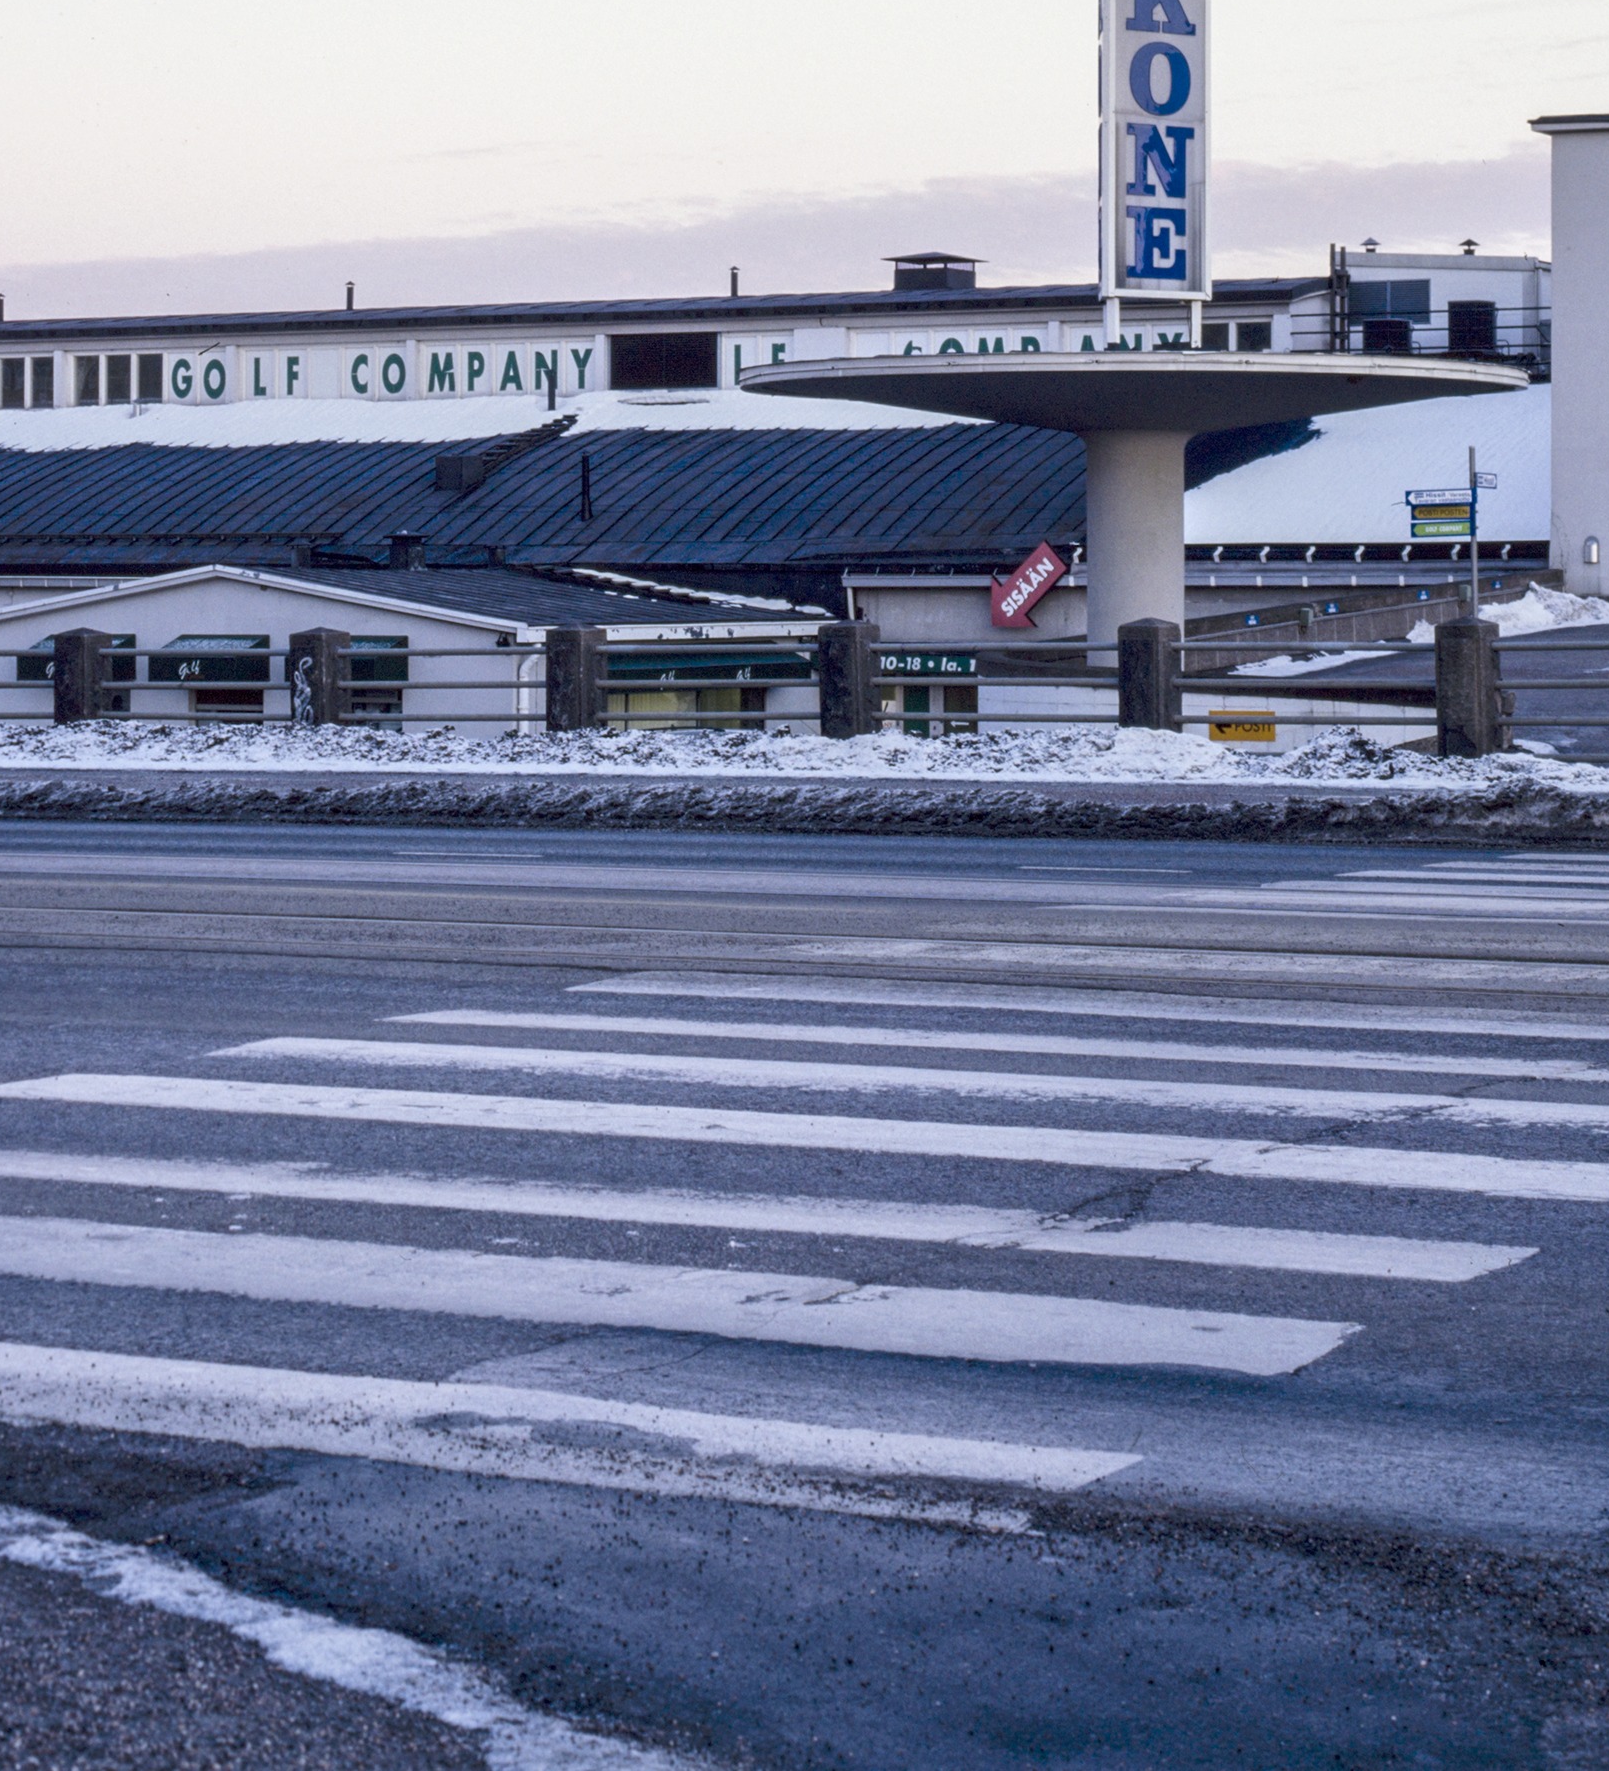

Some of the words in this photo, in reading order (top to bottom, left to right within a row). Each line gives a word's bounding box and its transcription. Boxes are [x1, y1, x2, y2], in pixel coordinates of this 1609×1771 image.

[171, 356, 299, 399] GOLF
[351, 348, 593, 394] COMPANY
[1001, 557, 1055, 617] SISÄÄN
[880, 656, 922, 671] 10-18
[941, 657, 962, 671] la.
